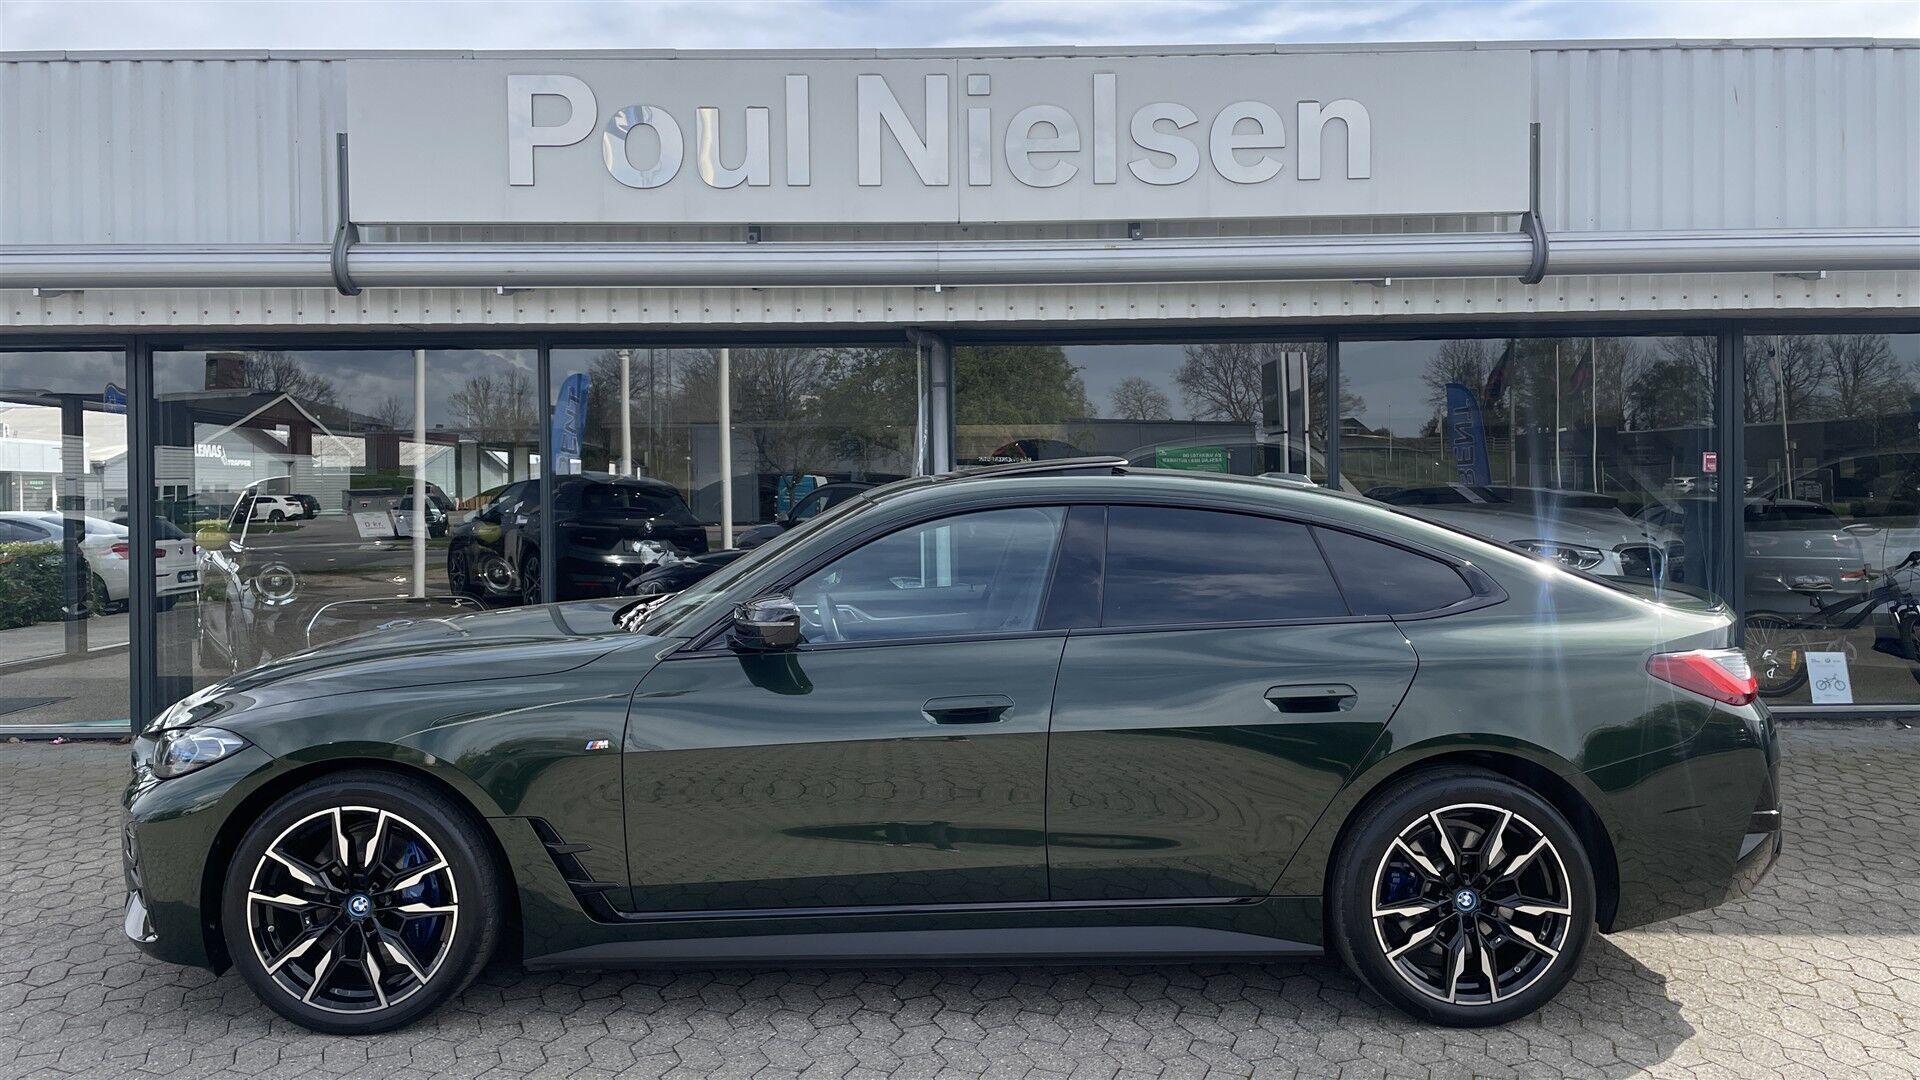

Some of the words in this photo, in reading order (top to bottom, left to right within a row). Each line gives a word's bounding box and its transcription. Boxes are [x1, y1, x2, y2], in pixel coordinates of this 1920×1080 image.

[506, 74, 811, 188] Poul
[857, 73, 1371, 188] Nielsen
[194, 444, 222, 457] LEMAS
